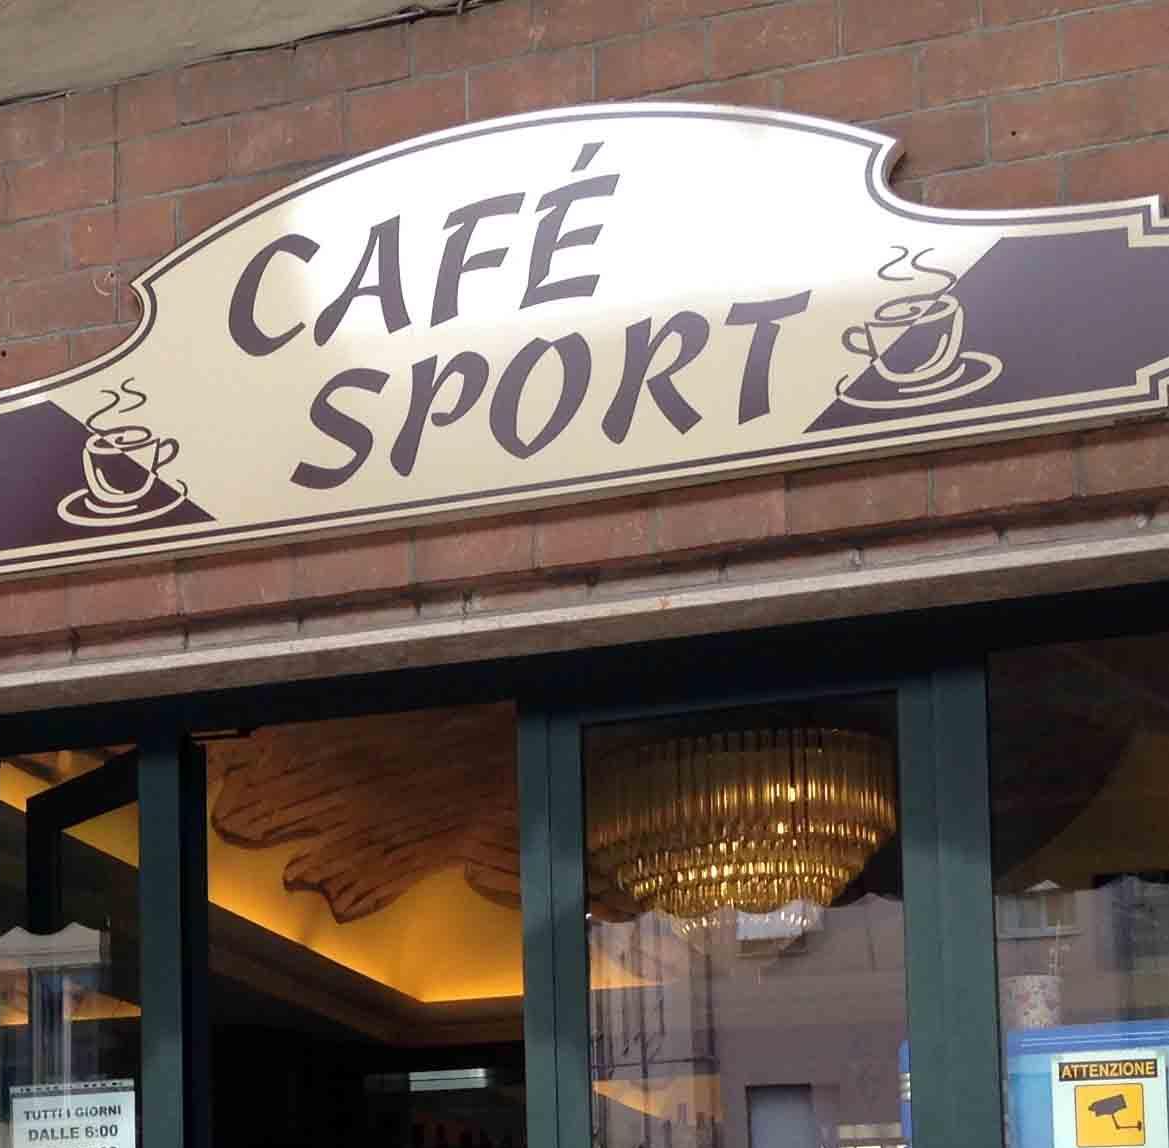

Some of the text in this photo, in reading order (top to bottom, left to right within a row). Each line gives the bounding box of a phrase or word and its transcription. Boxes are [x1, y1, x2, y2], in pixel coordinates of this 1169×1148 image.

[229, 142, 620, 357] CAFÉ
[290, 291, 811, 490] SPORT
[1062, 1061, 1155, 1078] ATTENZIONE
[23, 1108, 62, 1120] TUTTI
[74, 1104, 121, 1117] GIORNI
[28, 1124, 118, 1141] DALLE 6:00
